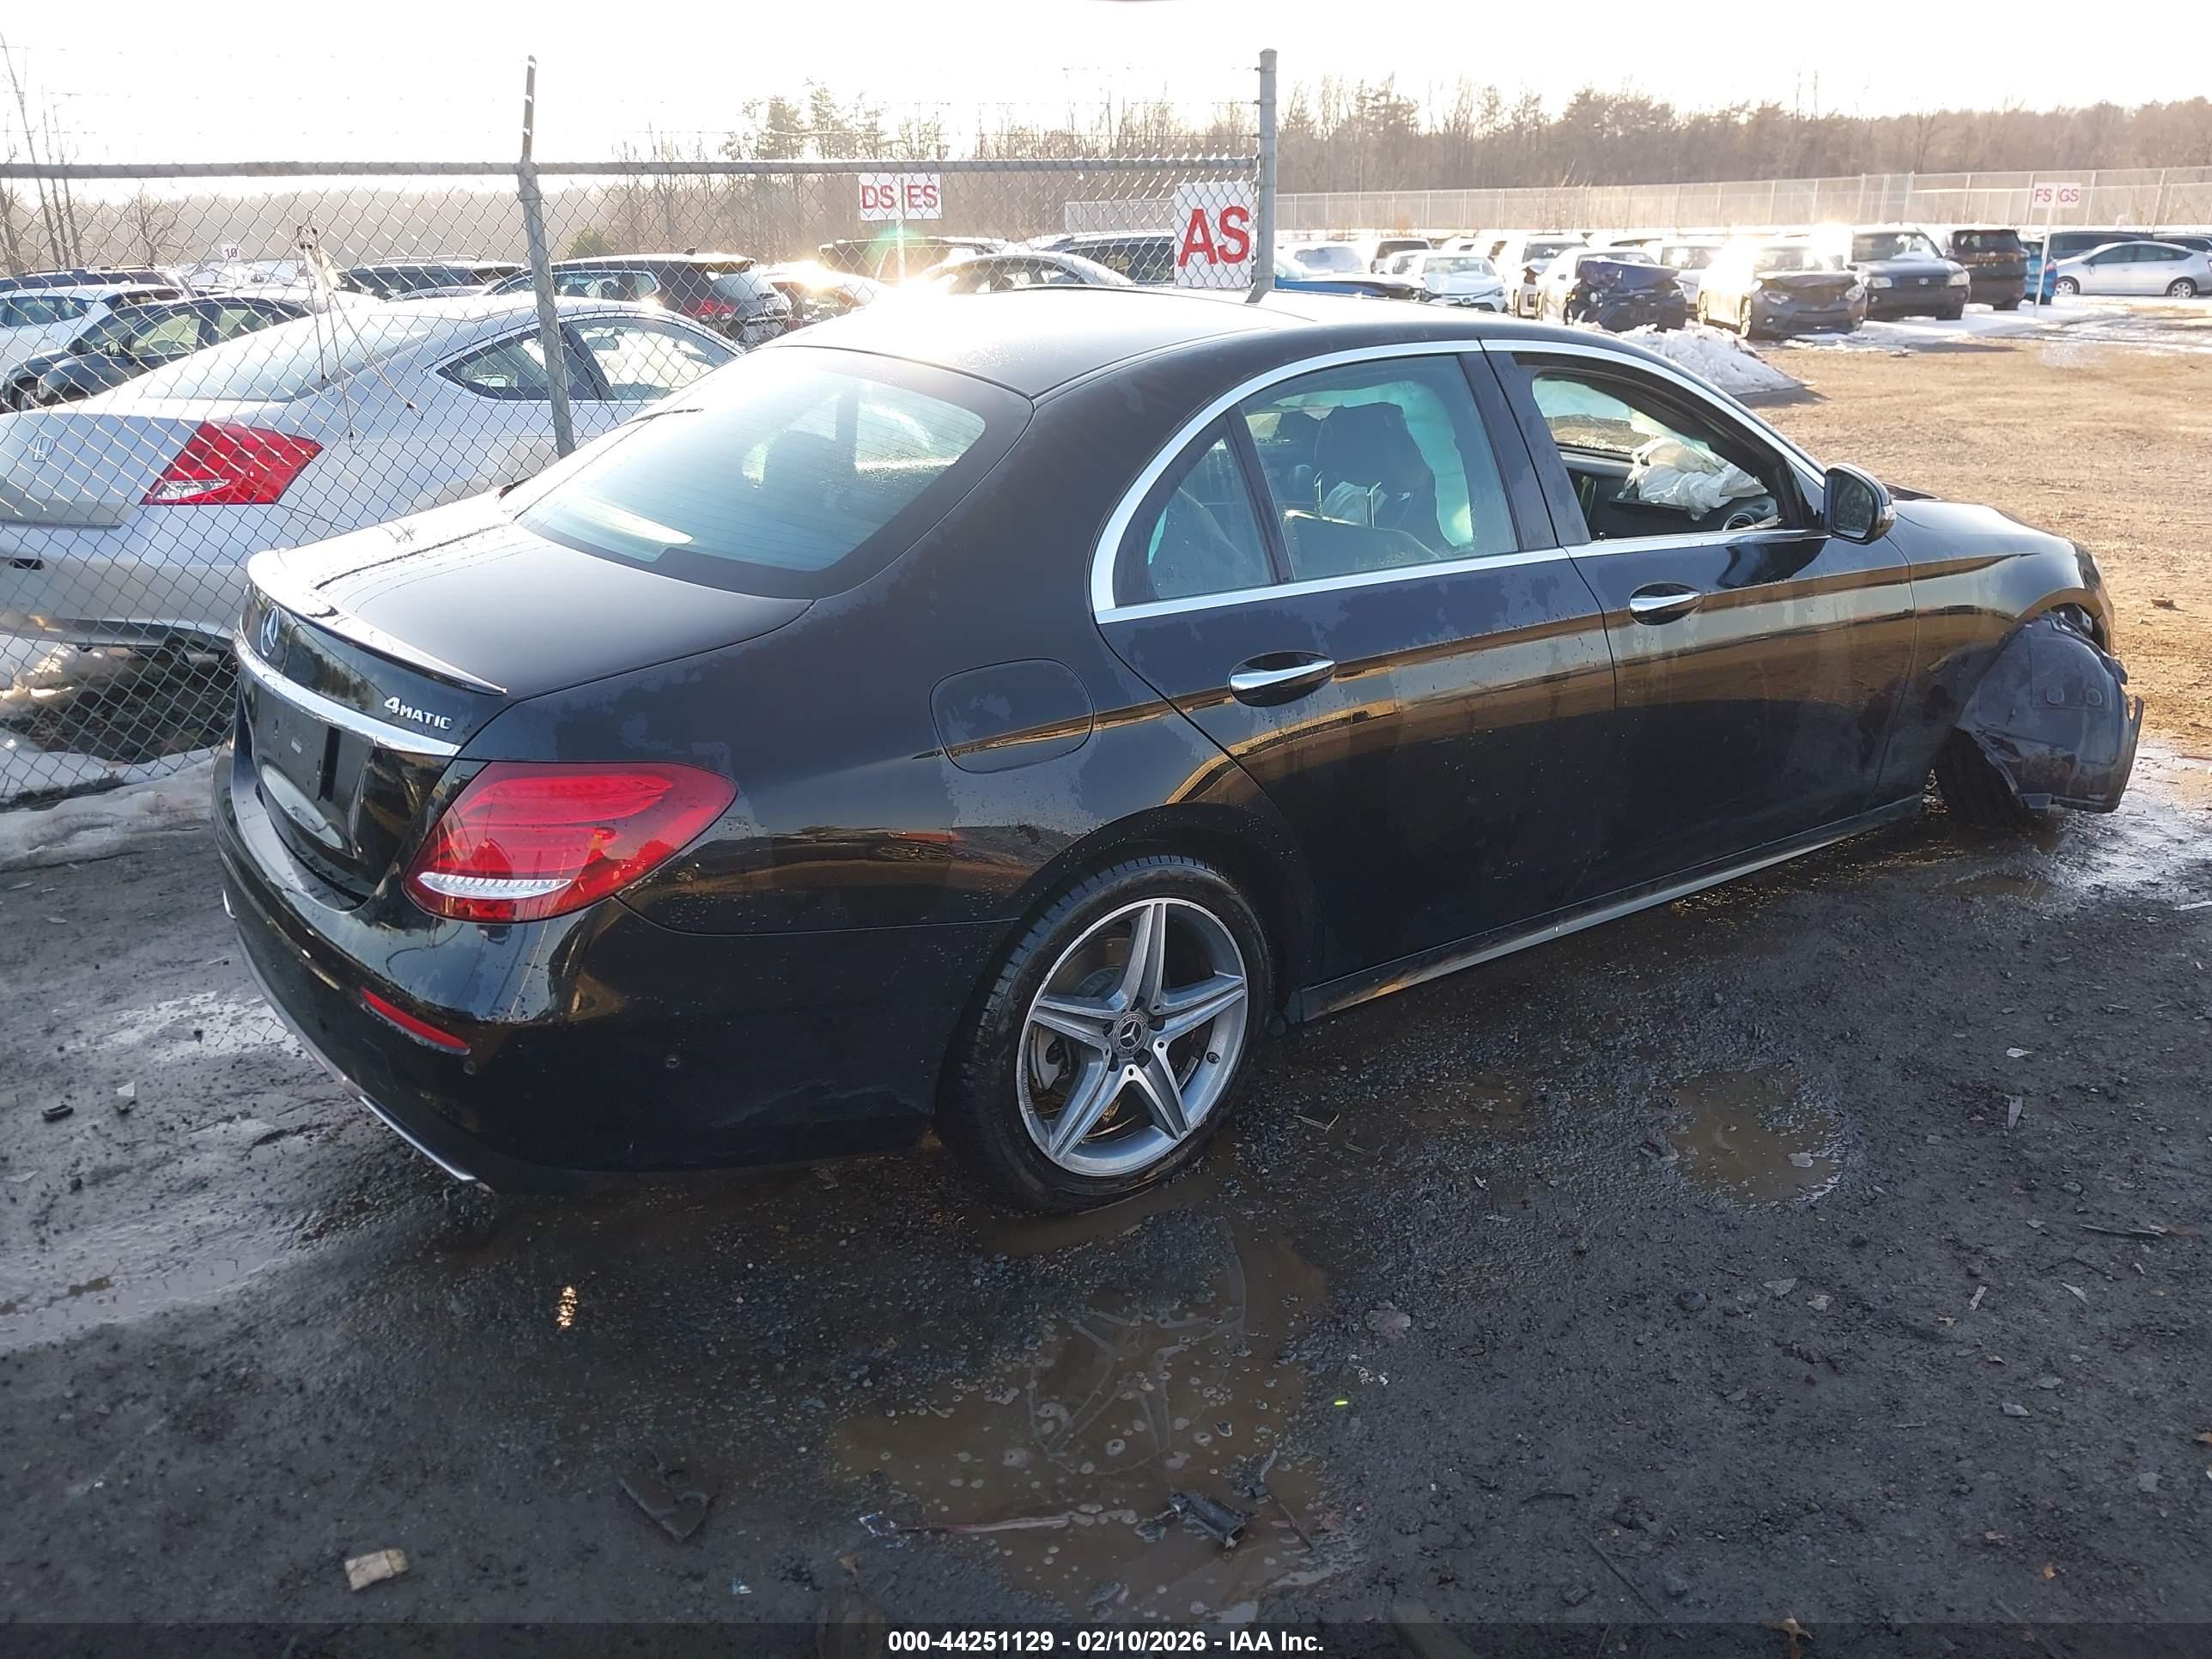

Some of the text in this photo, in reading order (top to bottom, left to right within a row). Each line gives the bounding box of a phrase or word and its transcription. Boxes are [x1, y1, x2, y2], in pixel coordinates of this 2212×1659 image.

[862, 185, 895, 209] DS
[907, 185, 938, 208] ES
[2034, 188, 2052, 202] FS
[2059, 188, 2079, 202] GS
[1177, 206, 1249, 267] AS
[384, 696, 453, 730] 4MATIC
